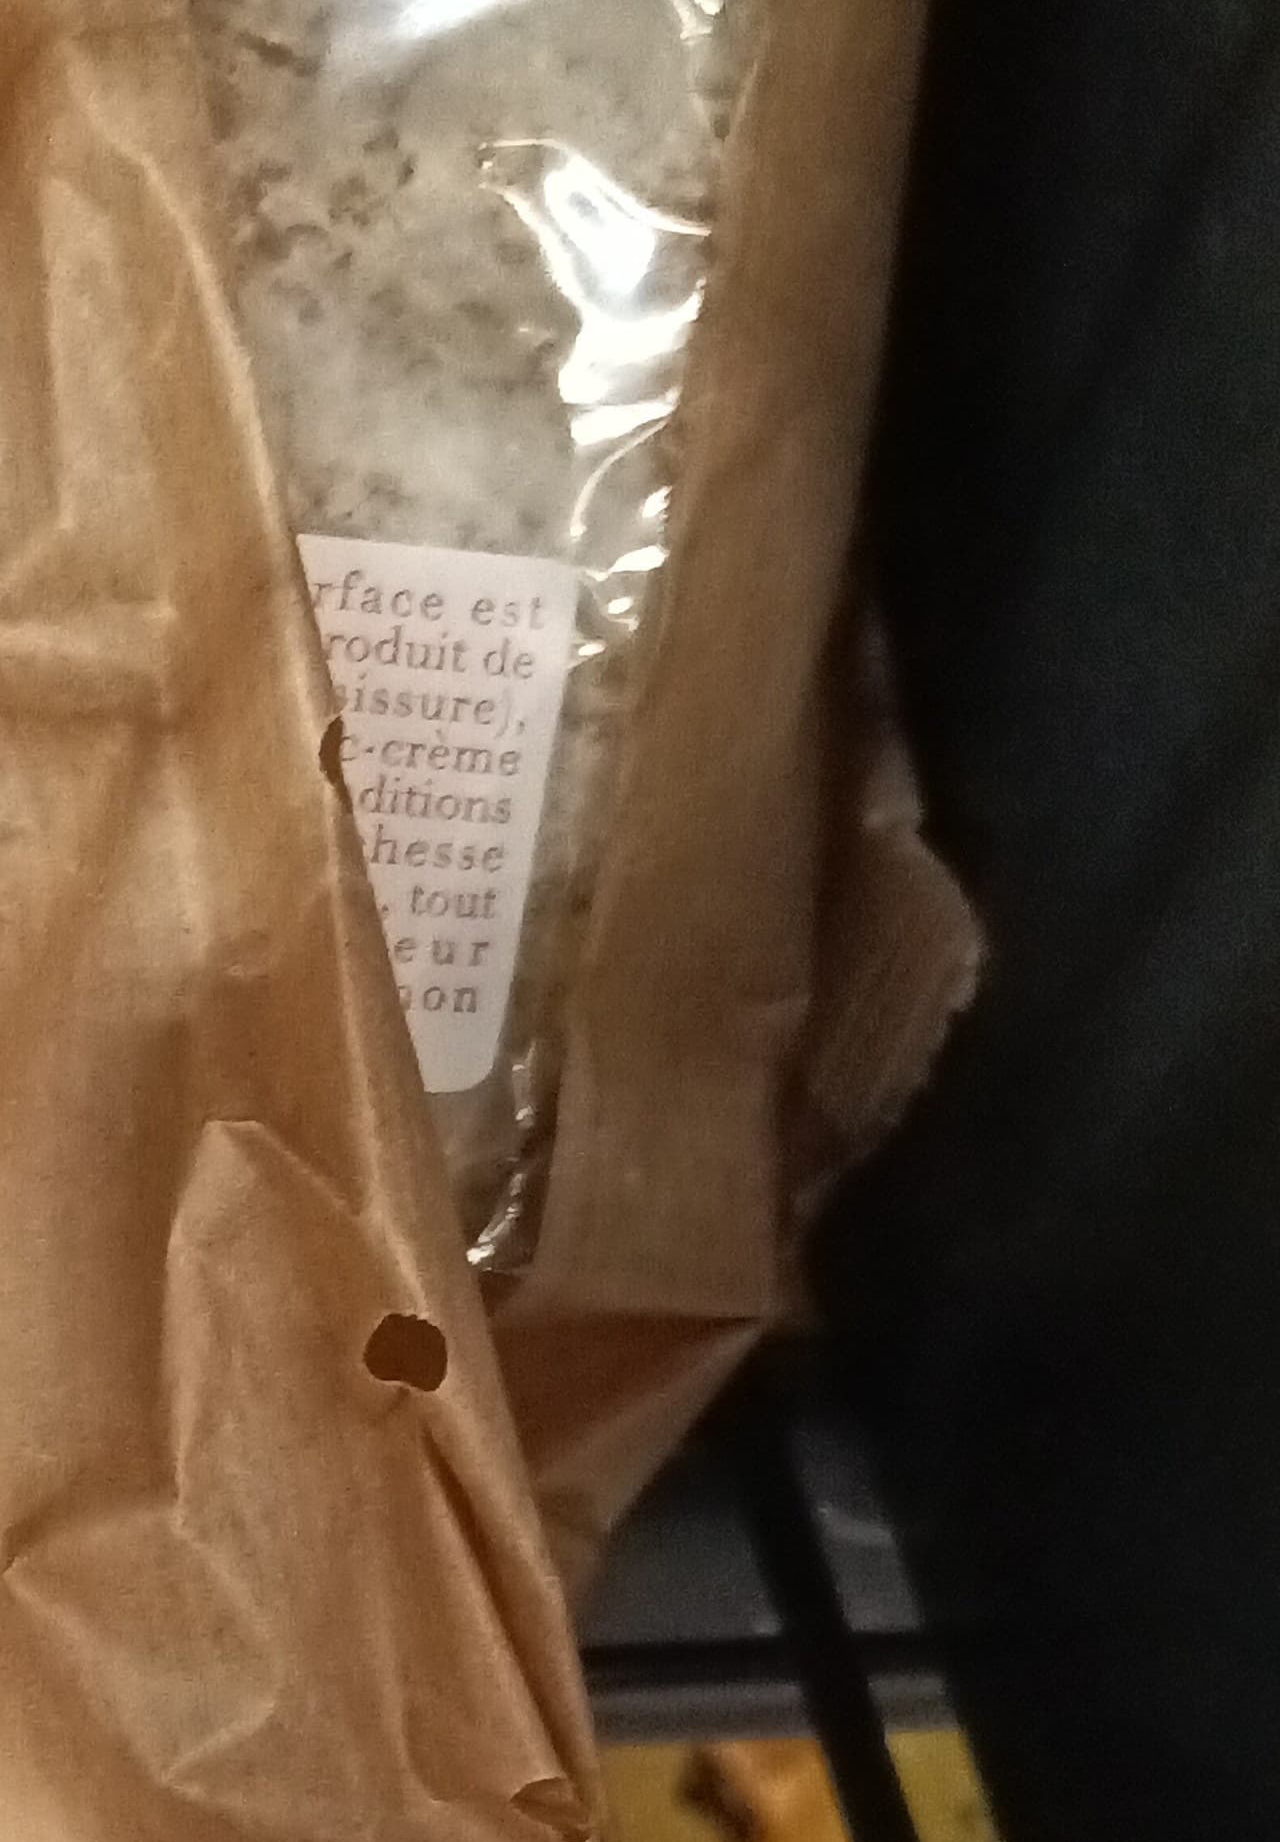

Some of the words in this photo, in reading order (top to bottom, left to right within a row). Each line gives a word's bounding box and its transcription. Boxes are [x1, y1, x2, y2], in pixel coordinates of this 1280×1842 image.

[471, 597, 545, 629] est
[483, 637, 534, 678] de
[410, 883, 497, 920] tout
